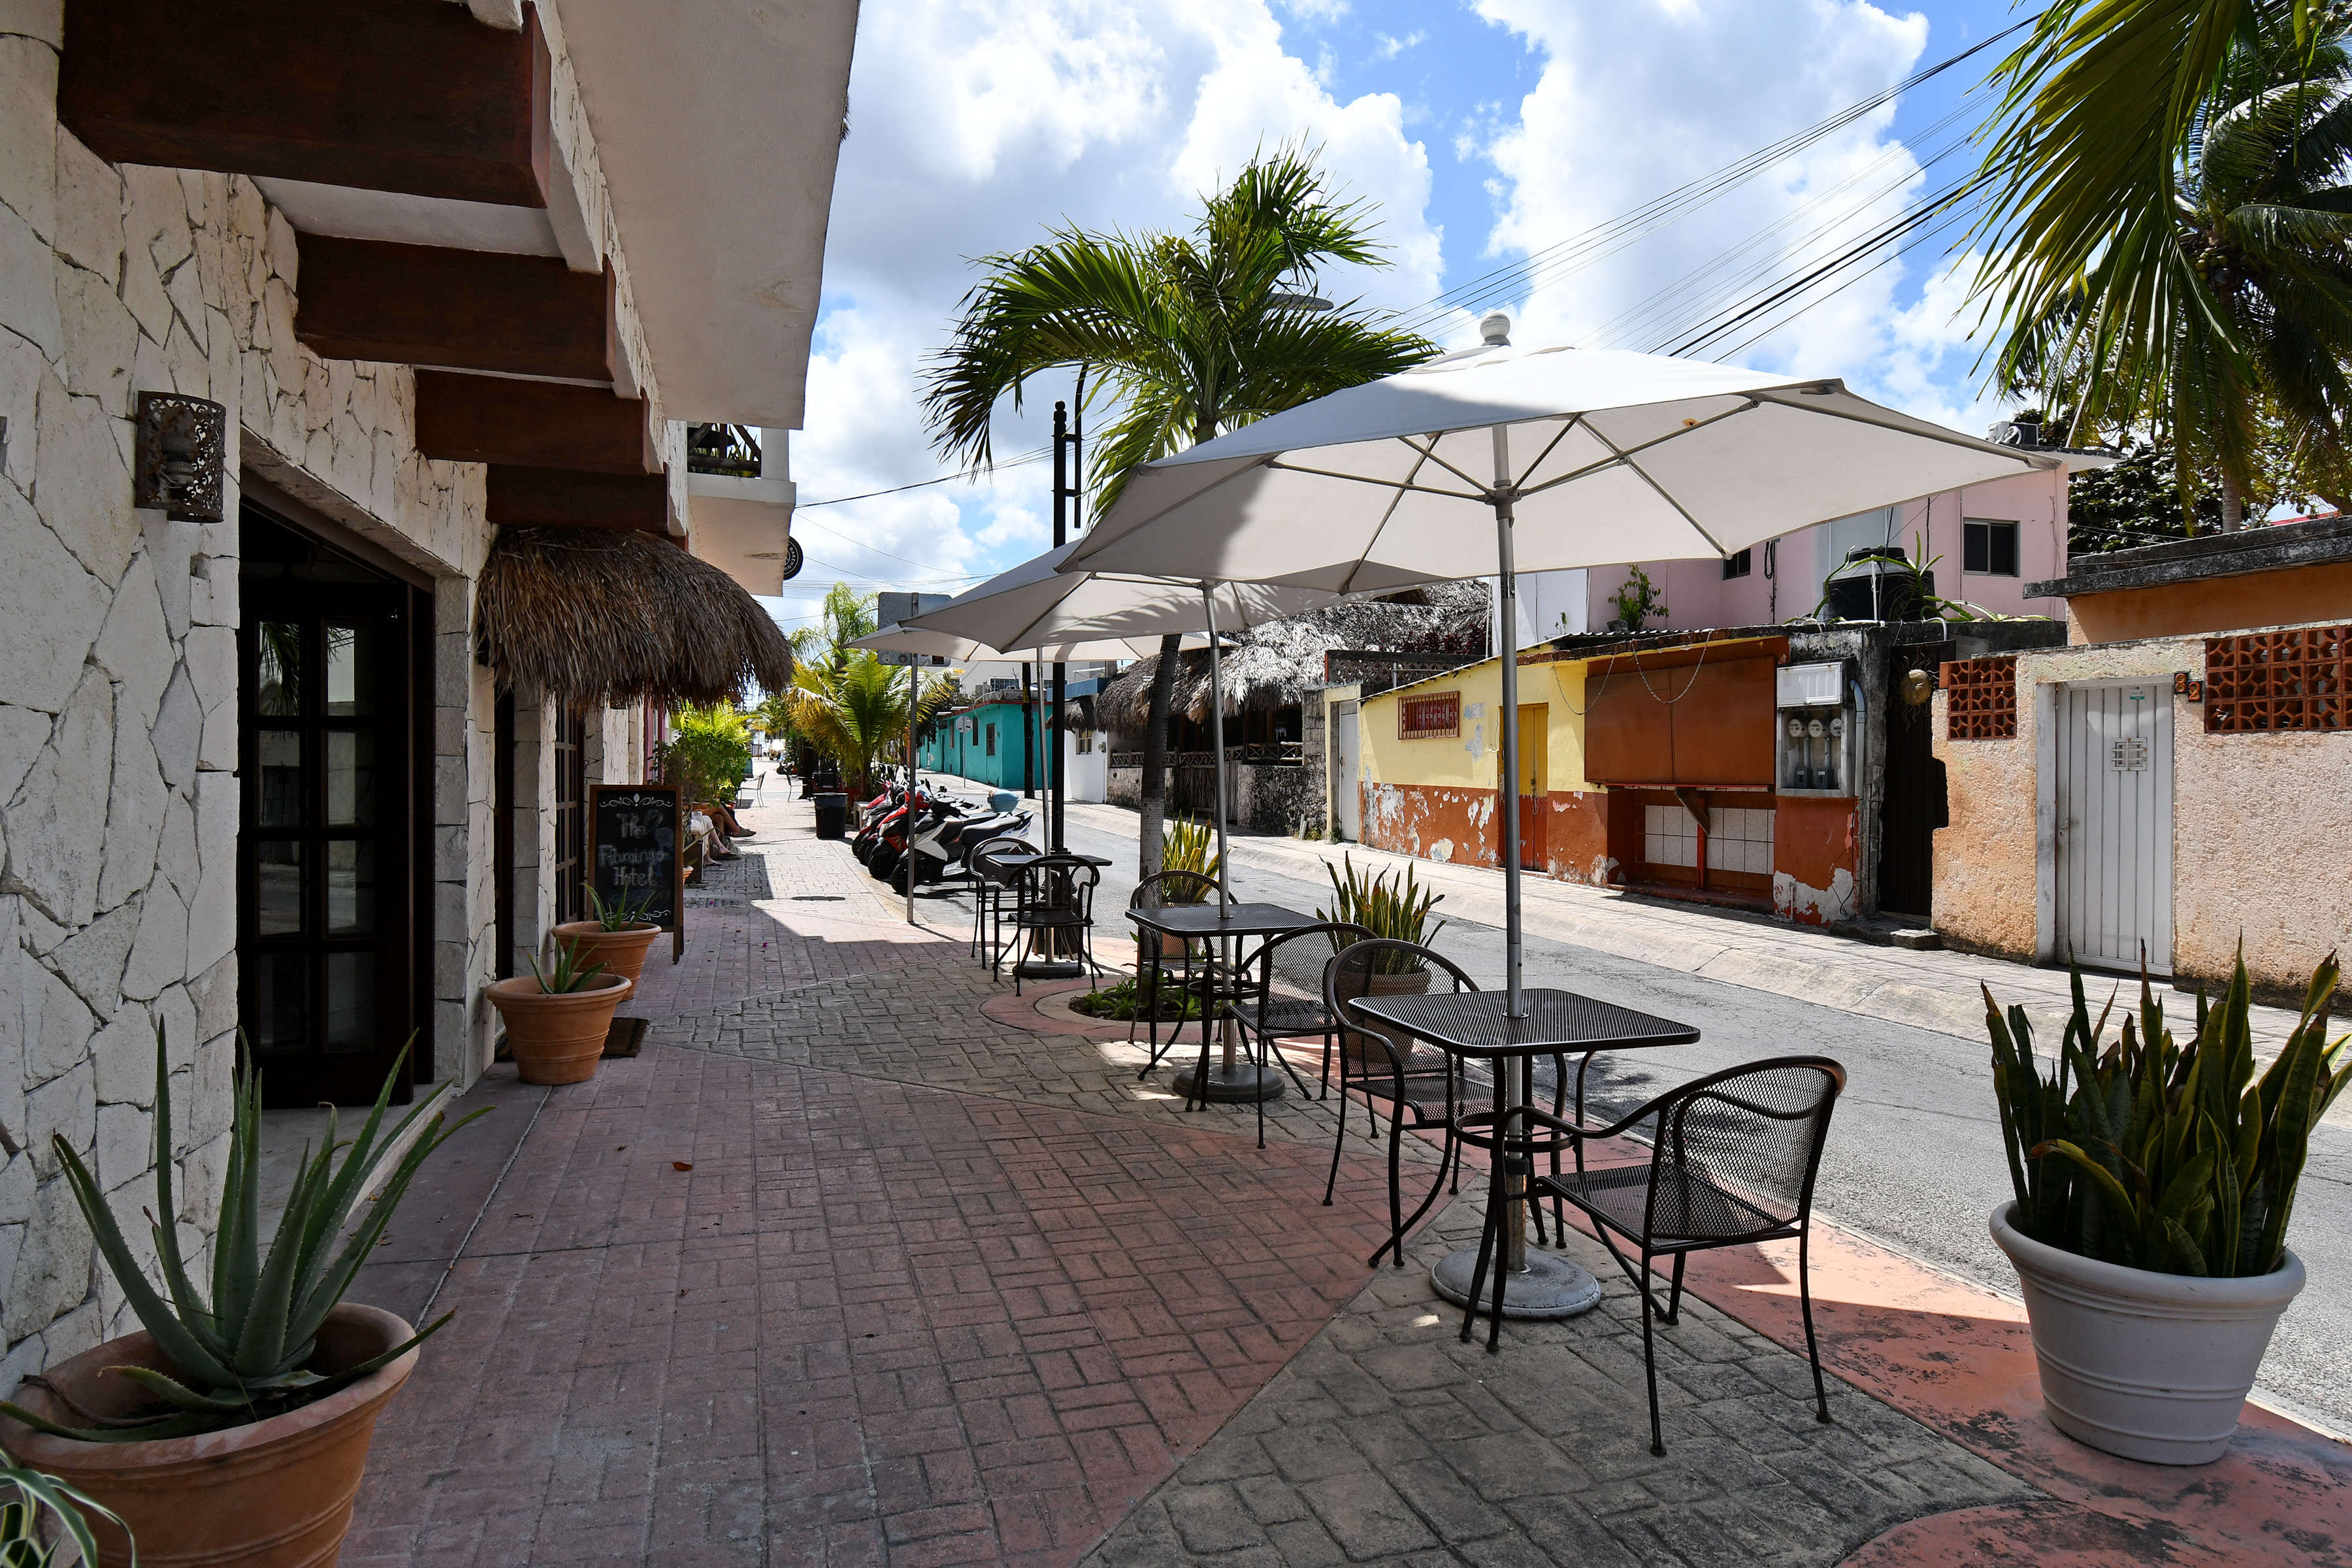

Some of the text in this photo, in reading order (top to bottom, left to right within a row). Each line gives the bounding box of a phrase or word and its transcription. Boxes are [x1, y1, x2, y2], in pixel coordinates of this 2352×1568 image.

[2175, 673, 2200, 700] 82
[617, 813, 649, 839] The
[598, 844, 668, 867] Flamingo
[613, 864, 657, 887] Hotel
